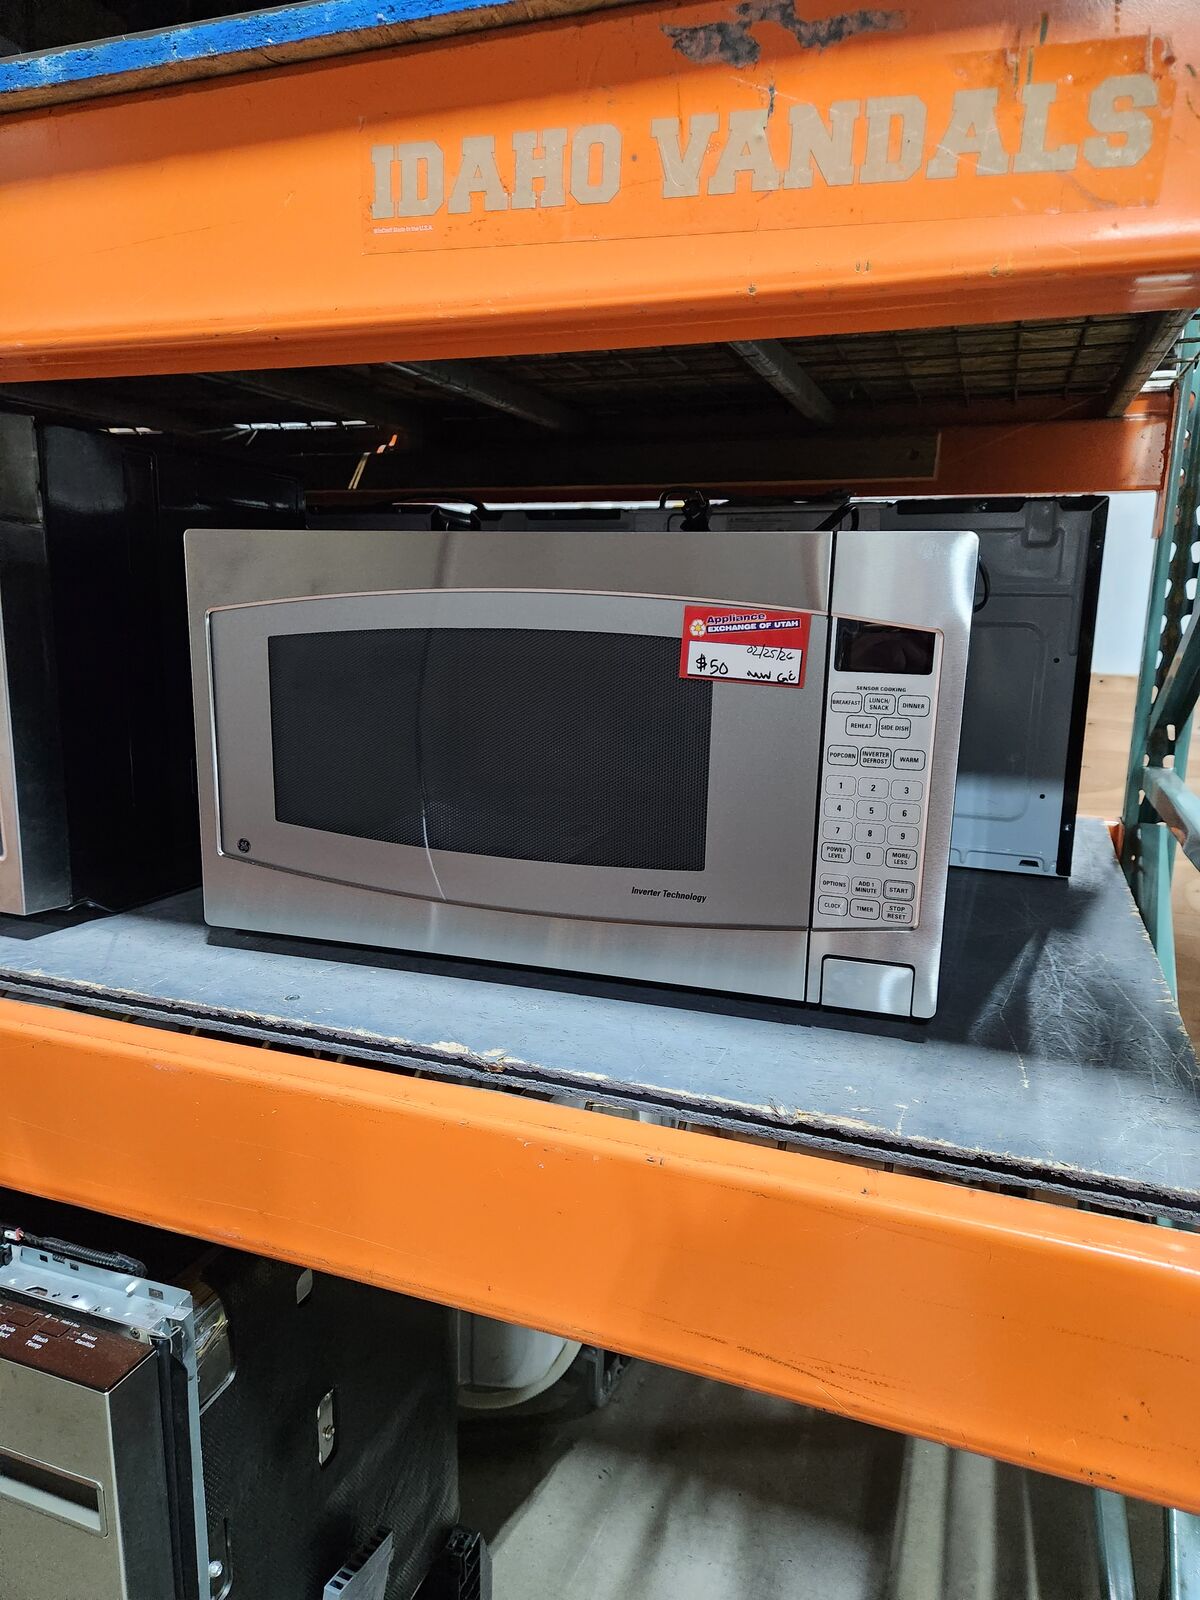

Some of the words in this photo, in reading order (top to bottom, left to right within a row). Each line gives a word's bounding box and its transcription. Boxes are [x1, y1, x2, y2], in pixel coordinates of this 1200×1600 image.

[371, 124, 622, 220] IDAHO
[650, 74, 1158, 198] VANDALS
[707, 613, 766, 624] Appliance
[708, 624, 756, 632] EXCHANGE
[696, 654, 728, 674] $50
[871, 784, 876, 792] 2
[632, 887, 661, 897] Inverter
[663, 890, 707, 903] Technology
